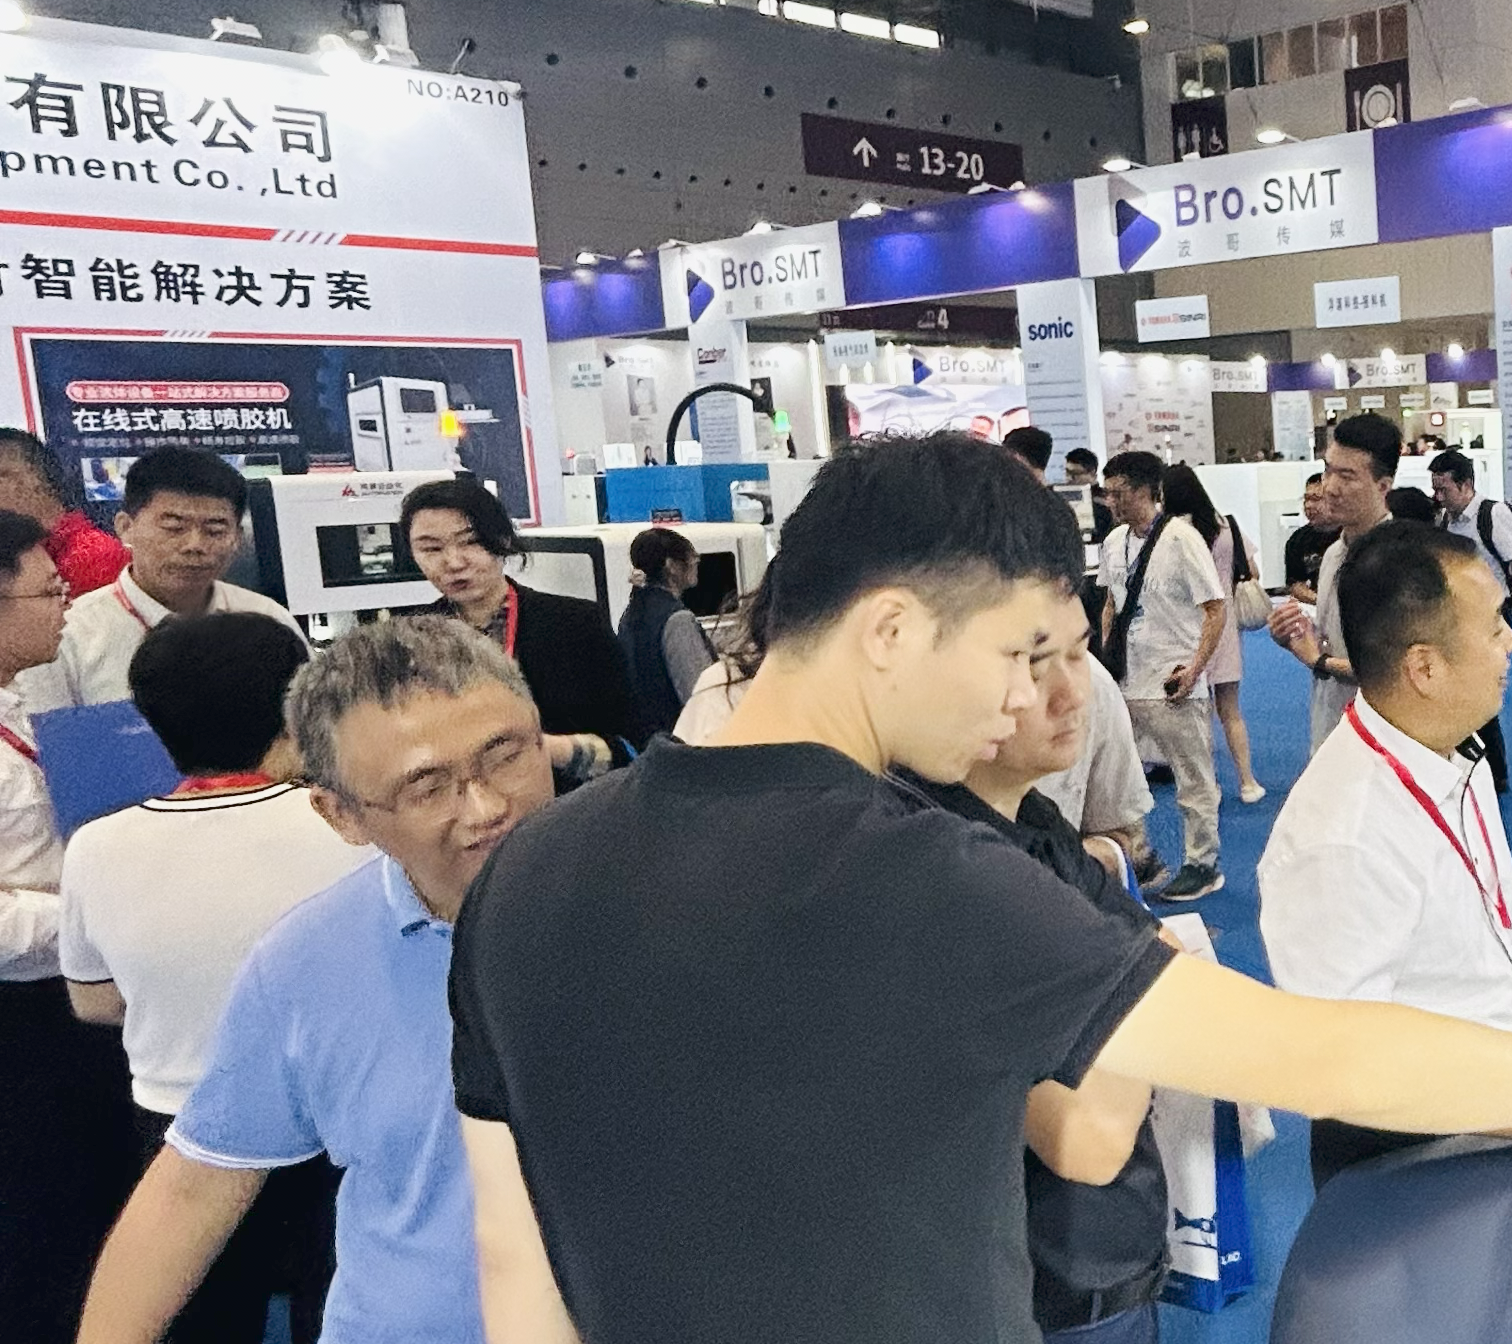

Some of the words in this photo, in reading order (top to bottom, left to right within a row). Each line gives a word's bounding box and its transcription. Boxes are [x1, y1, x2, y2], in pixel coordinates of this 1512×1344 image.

[4, 72, 332, 163] 有限公司
[0, 150, 160, 184] pment
[920, 146, 984, 181] 13-20
[1174, 168, 1342, 227] Bro.SMT
[0, 253, 372, 311] 智能解决方案
[721, 249, 821, 290] Bro.SMT
[1028, 316, 1074, 340] sonic
[939, 356, 1006, 373] Bro.SMT
[1366, 363, 1417, 377] Bro.SMT
[72, 407, 292, 433] 在线式高速喷胶机
